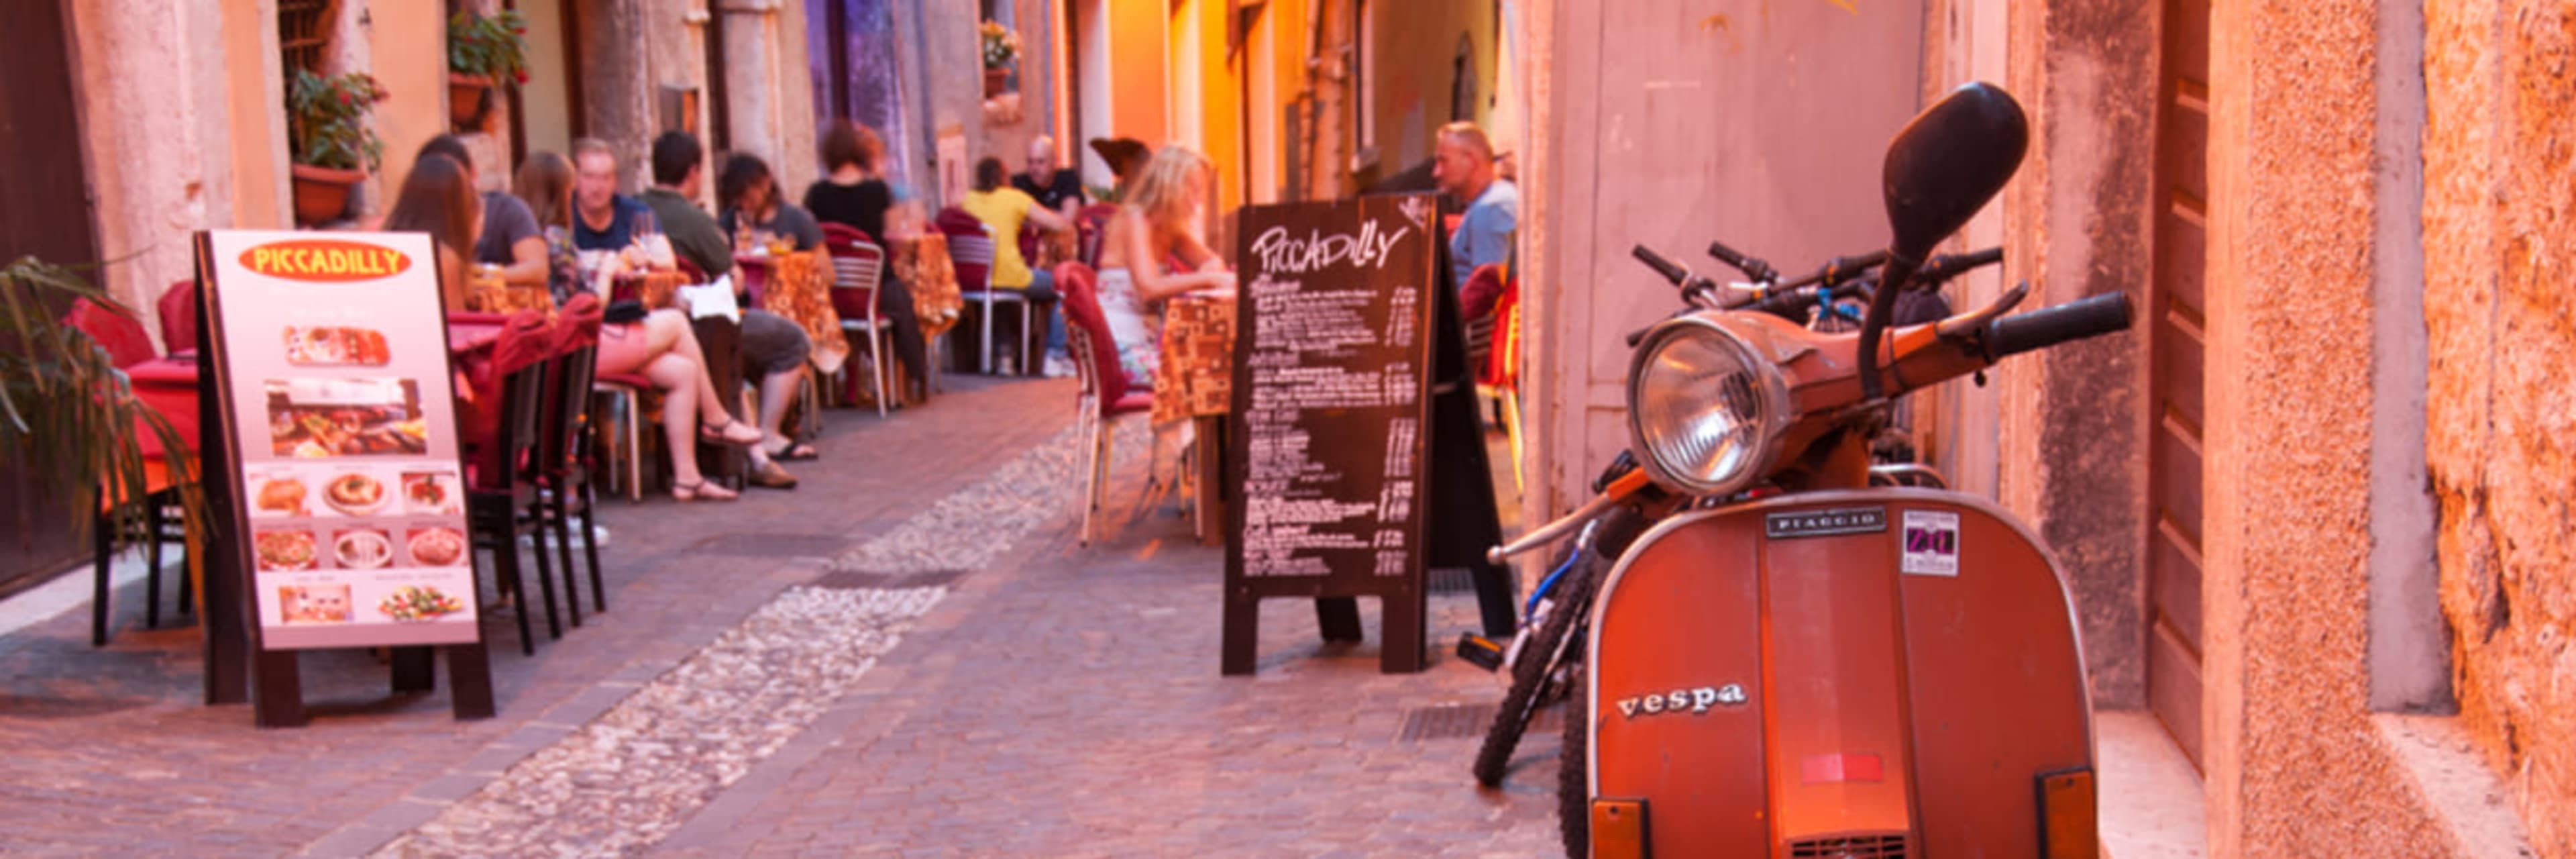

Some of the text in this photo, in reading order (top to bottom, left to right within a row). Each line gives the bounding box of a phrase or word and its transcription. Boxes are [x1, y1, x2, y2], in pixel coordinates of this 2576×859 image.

[253, 246, 400, 275] PICCADILLY
[1779, 513, 1874, 530] PIAGGIO
[1616, 683, 1748, 718] vespa
